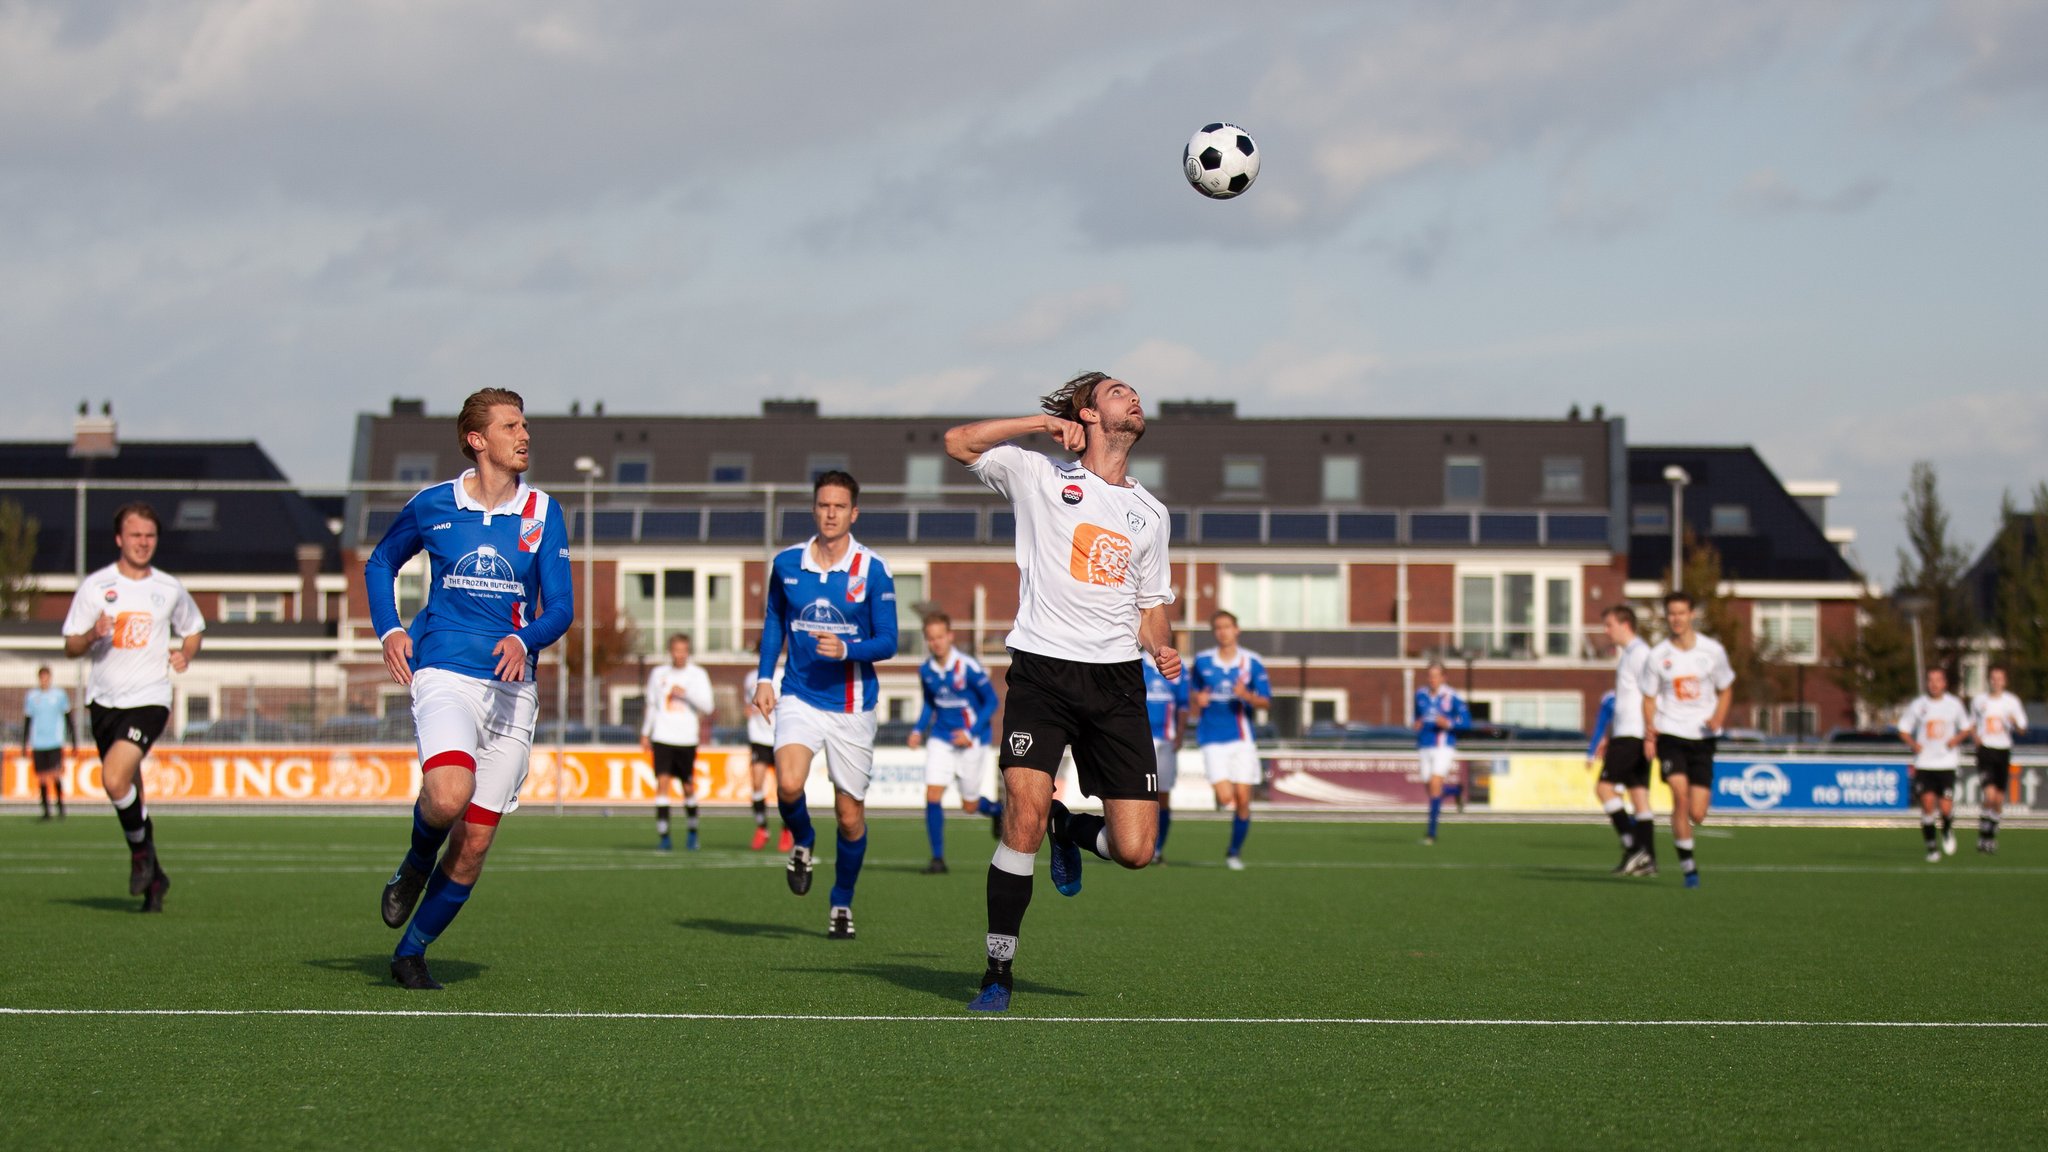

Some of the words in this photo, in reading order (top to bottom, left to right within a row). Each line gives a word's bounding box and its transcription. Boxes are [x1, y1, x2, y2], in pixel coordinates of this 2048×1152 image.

[1064, 488, 1083, 498] SPORT
[433, 522, 451, 530] JAKO
[449, 577, 461, 585] THE
[461, 579, 489, 588] FROZEN
[128, 726, 142, 741] 10
[208, 758, 315, 798] ING
[1145, 773, 1157, 792] 11
[1718, 775, 1791, 797] renewi
[1836, 767, 1898, 789] waste
[1812, 785, 1841, 805] no
[1843, 785, 1898, 806] more
